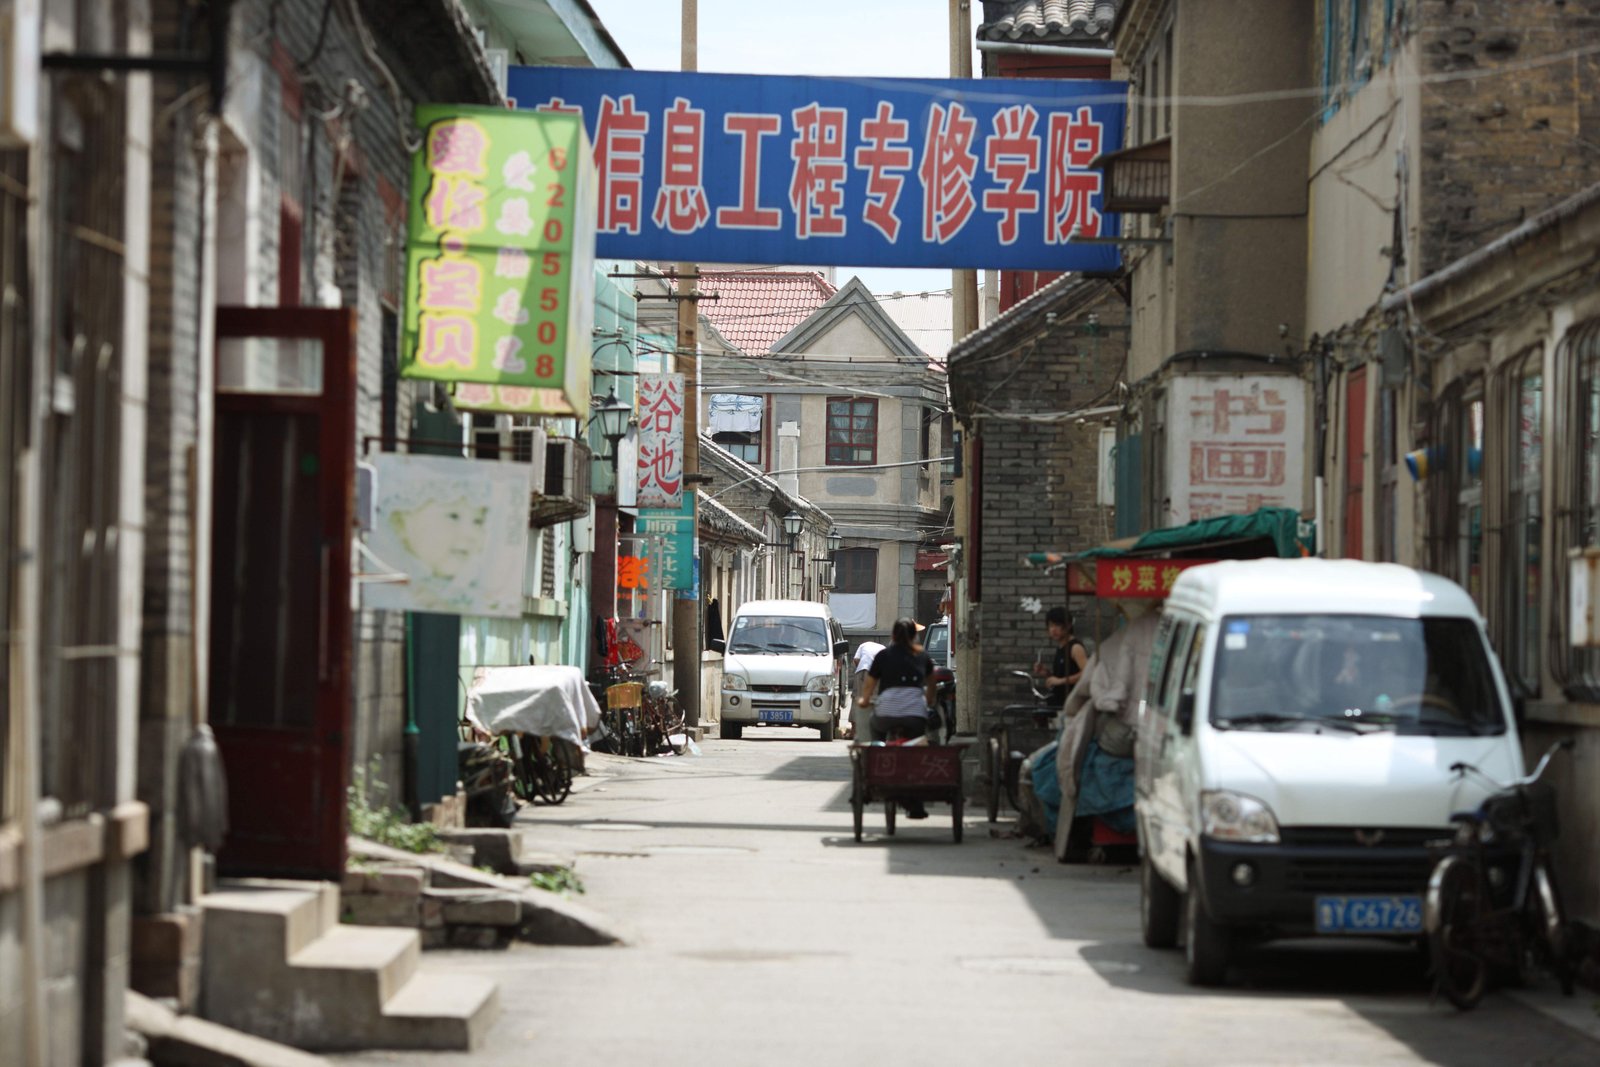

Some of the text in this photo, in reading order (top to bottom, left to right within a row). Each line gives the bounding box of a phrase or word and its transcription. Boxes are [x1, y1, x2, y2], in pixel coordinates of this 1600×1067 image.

[505, 95, 1104, 246] 信息工程专修学院
[534, 147, 568, 378] 6205508
[638, 380, 682, 496] 浴池
